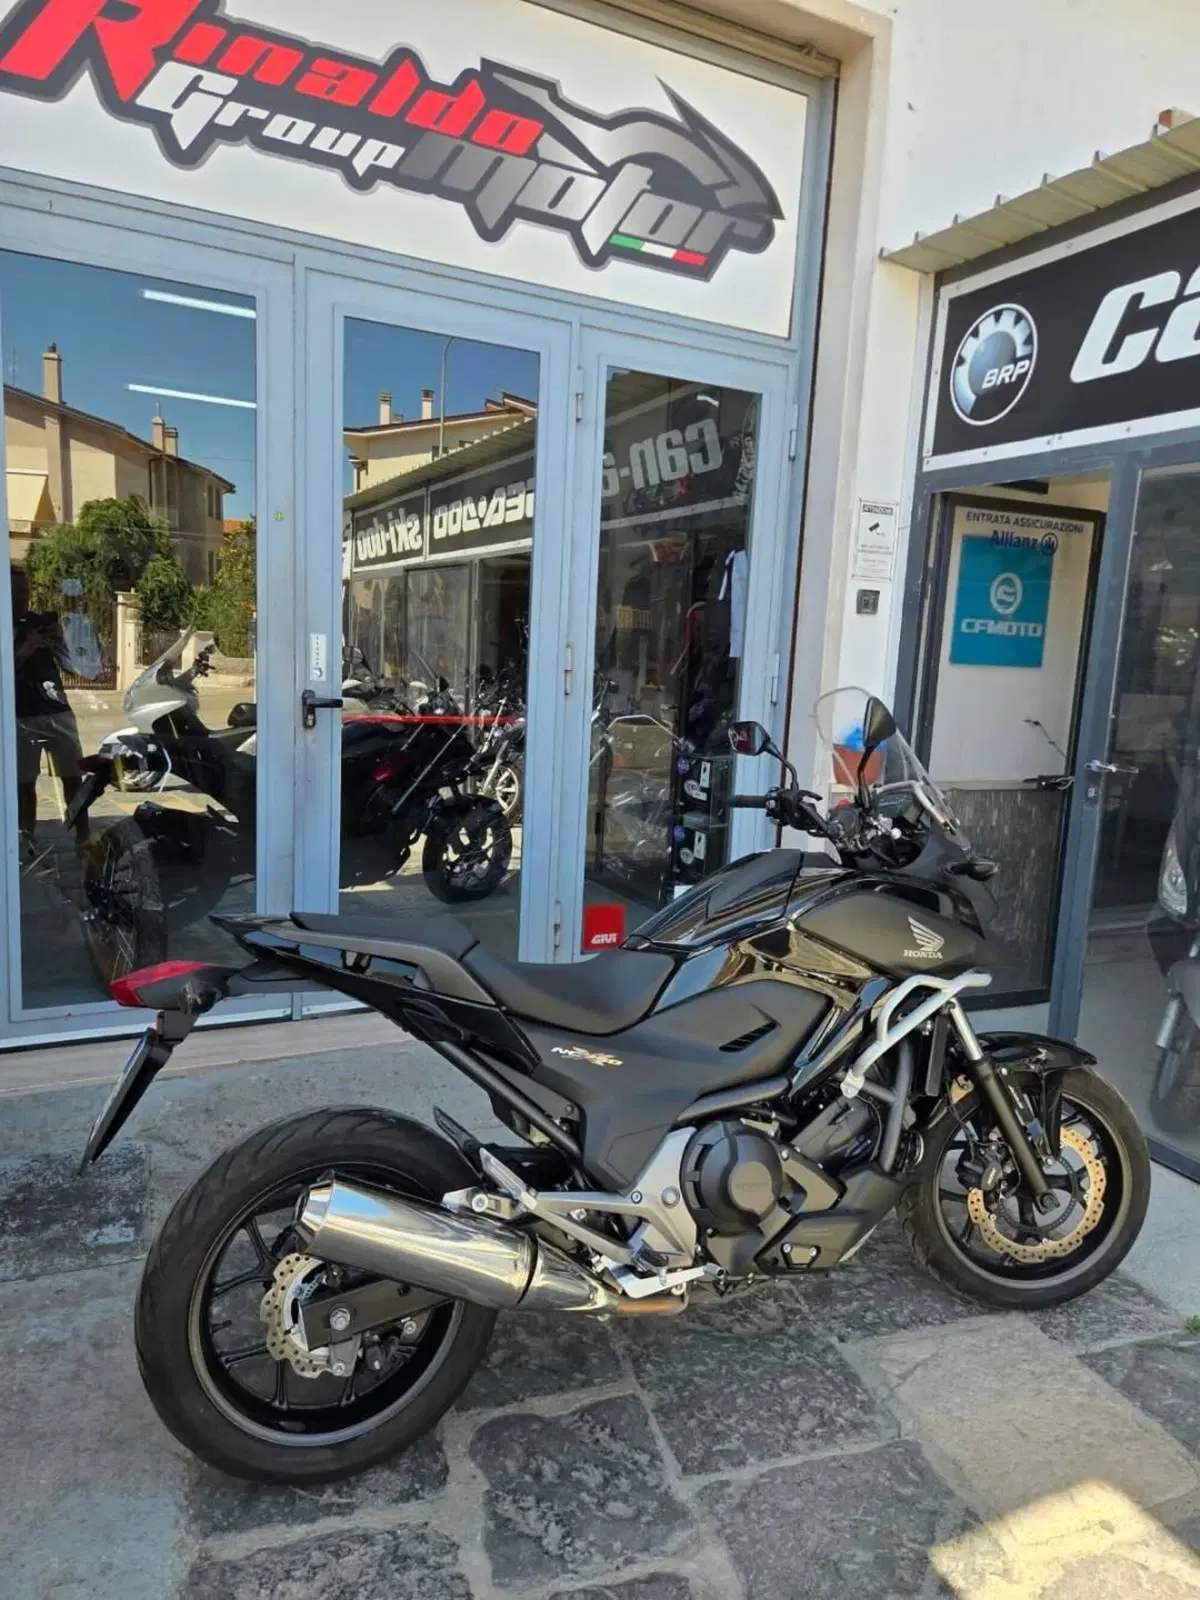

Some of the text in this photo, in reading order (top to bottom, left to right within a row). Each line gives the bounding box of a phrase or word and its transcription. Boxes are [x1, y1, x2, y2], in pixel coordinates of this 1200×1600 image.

[0, 0, 544, 156] Rinaldo
[135, 61, 405, 177] Group
[982, 359, 1031, 390] BRP
[966, 510, 1085, 533] ENTRATA ASSICURAZIONI
[989, 529, 1038, 549] Allianz
[961, 618, 1043, 637] CFMOTO
[590, 932, 618, 945] GIVI
[903, 949, 944, 960] HONDA
